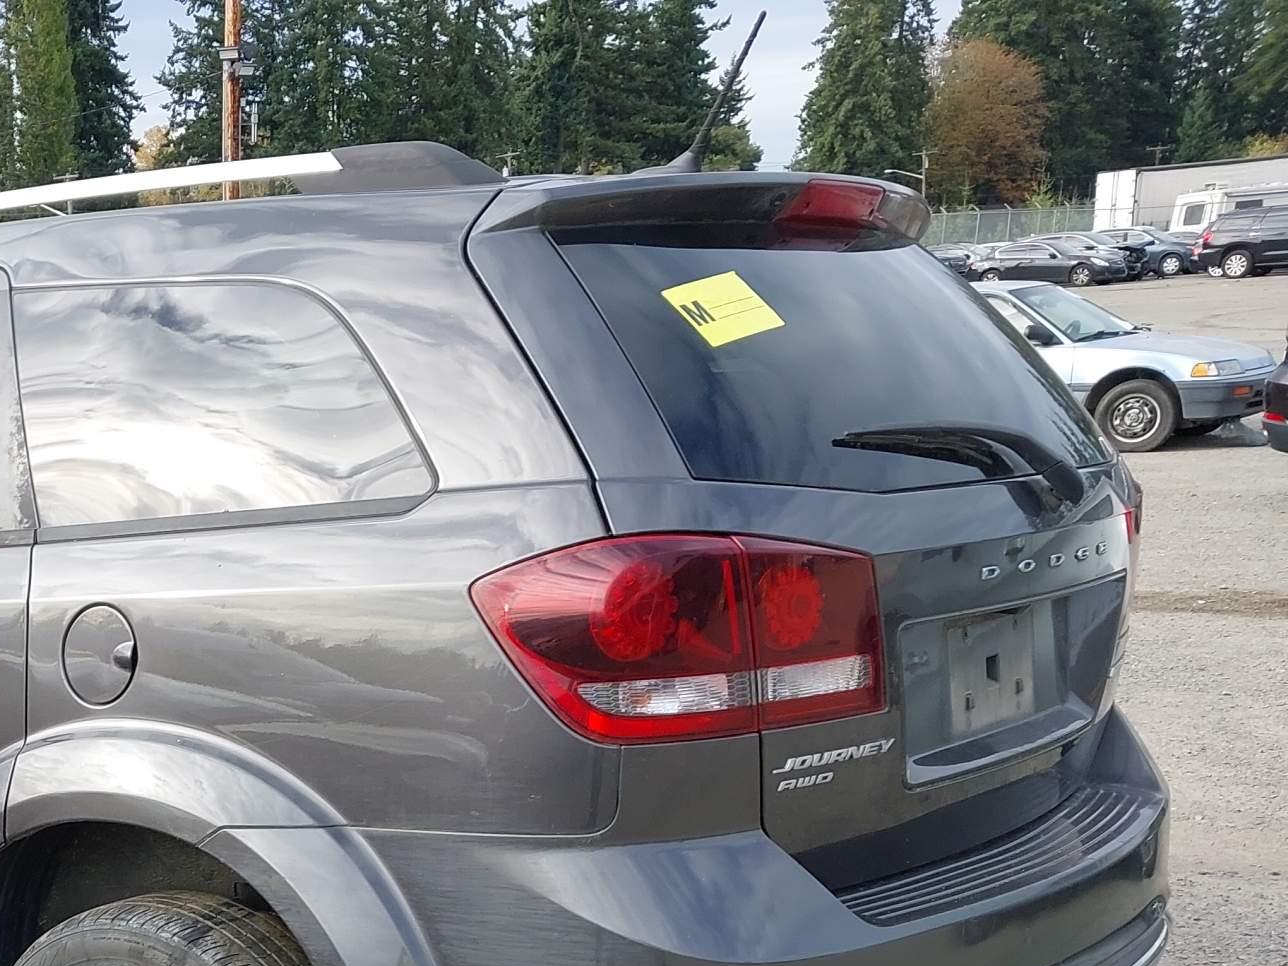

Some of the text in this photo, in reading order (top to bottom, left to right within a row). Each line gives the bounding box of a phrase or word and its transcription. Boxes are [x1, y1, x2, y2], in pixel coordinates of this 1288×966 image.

[679, 300, 717, 327] M
[981, 542, 1108, 580] DODGE
[772, 738, 896, 774] JOURNEY
[777, 772, 834, 792] AWD
